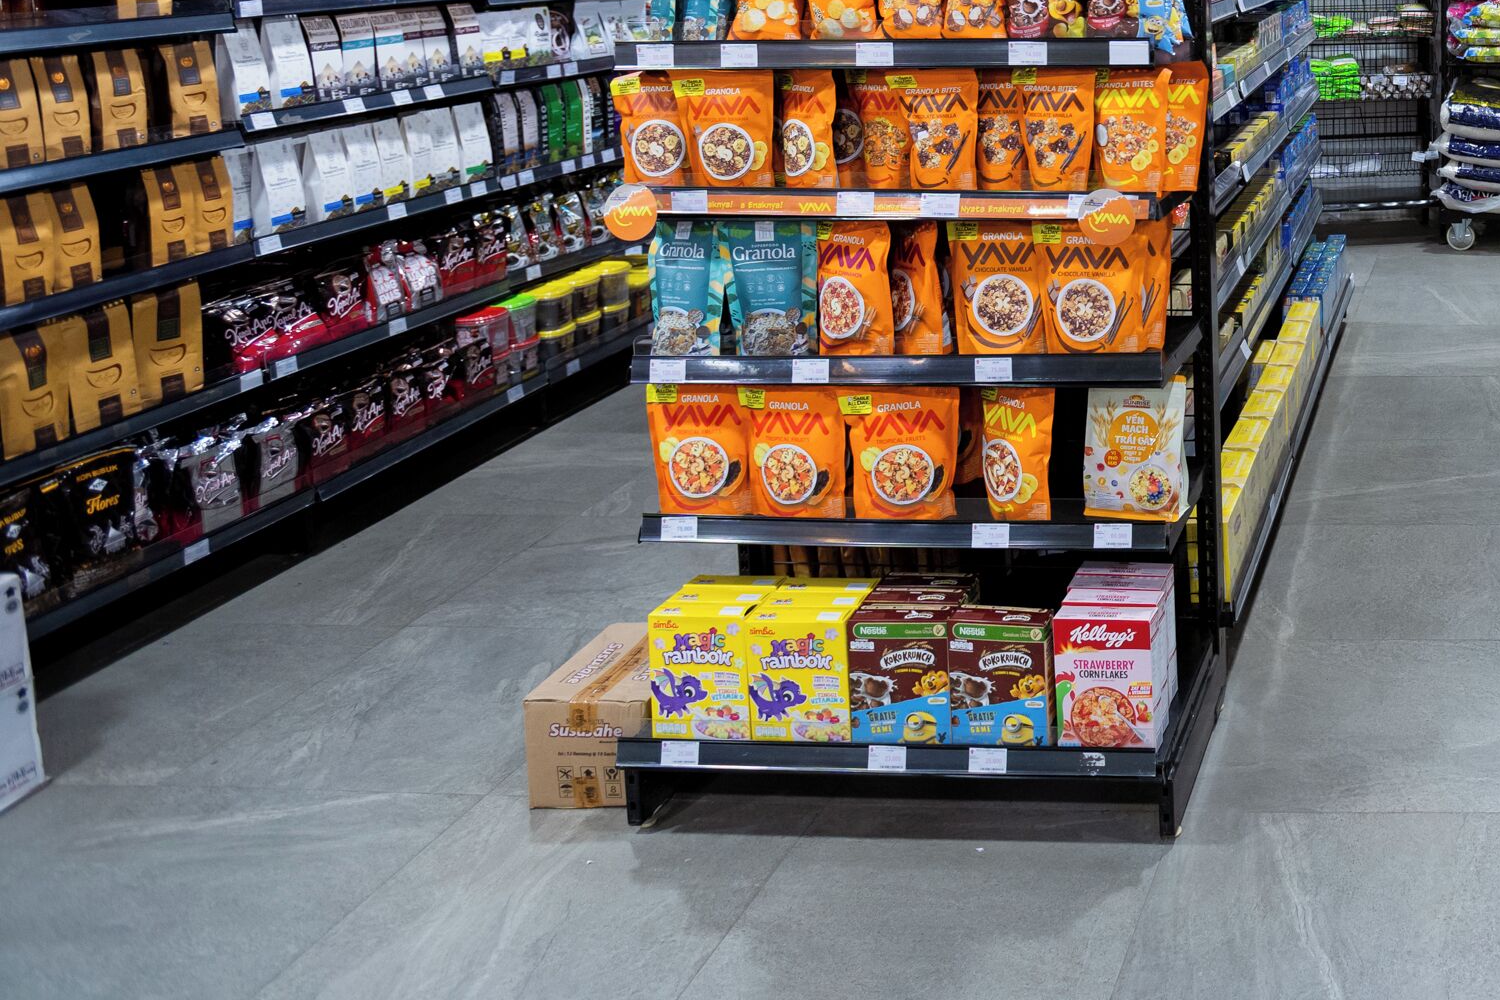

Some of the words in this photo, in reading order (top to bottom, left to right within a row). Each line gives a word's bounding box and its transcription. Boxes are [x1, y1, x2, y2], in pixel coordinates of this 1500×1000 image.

[1129, 80, 1154, 88] BITES
[705, 87, 740, 95] GRANOLA
[618, 206, 652, 218] YAVA
[799, 202, 831, 213] YAVA
[960, 205, 986, 214] Nyata
[987, 205, 1024, 214] Enaknya!
[1093, 213, 1130, 224] YAVA
[833, 234, 865, 245] GRANOLA
[982, 232, 1023, 241] GRANOLA
[659, 243, 705, 260] Granola
[732, 246, 796, 261] Granola
[961, 242, 1035, 270] YAVA
[1045, 246, 1129, 273] YAVA
[681, 394, 719, 402] GRANOLA
[999, 395, 1024, 409] GRANOLA
[769, 402, 809, 410] GRANOLA
[877, 402, 921, 412] GRANOLA
[662, 404, 741, 431] YAVA
[984, 404, 1036, 438] YAVA
[751, 412, 829, 438] YAVA
[858, 410, 945, 441] YAVA
[86, 494, 120, 515] Flores
[653, 621, 679, 629] simba
[749, 627, 776, 636] simba
[1070, 623, 1137, 647] Kellogg's
[674, 627, 725, 654] Magic
[771, 633, 824, 656] Magic
[663, 648, 734, 666] rainbow
[760, 653, 833, 671] rainbow
[884, 654, 902, 666] KOKO
[903, 651, 932, 662] KRUNCH
[982, 654, 1000, 668] KOKO
[1001, 652, 1030, 665] KRUNCH
[1074, 660, 1134, 669] STRAWBERRY
[868, 711, 896, 721] GRATIS
[967, 711, 996, 721] GRATIS
[870, 724, 893, 734] GAME
[969, 725, 992, 734] GAME
